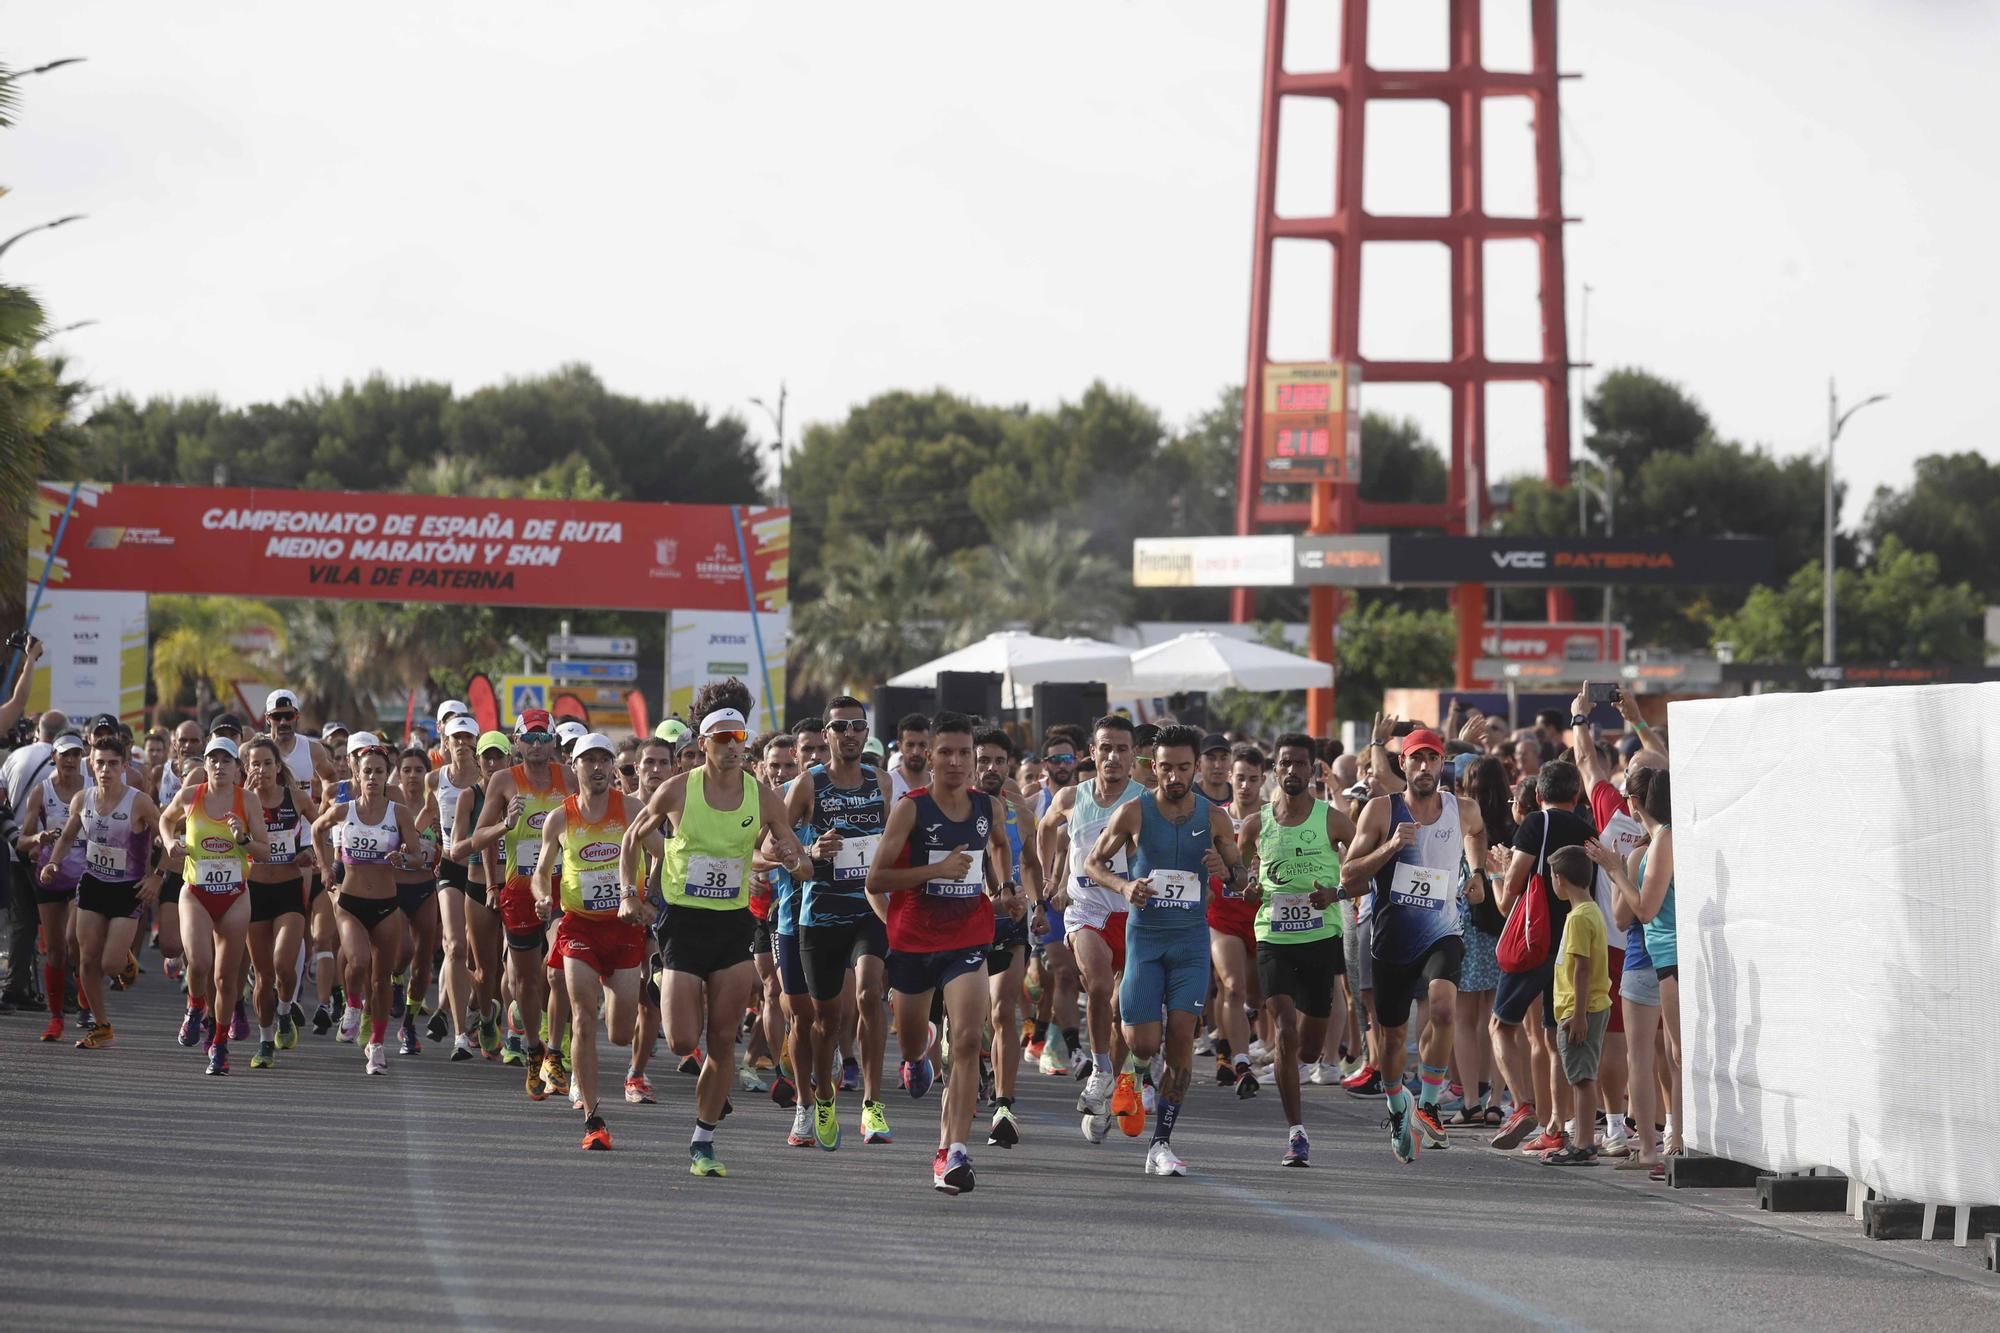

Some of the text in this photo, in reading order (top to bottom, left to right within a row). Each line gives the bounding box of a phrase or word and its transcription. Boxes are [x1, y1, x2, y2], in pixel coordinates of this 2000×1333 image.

[202, 508, 622, 543] CAMPEONATO DE ESPAÑA DE RUTA
[265, 536, 561, 566] MEDIO MARATÓN Y 5KM
[1492, 551, 1675, 568] VCC PATERNA
[309, 564, 514, 590] VILA DE PATERNA
[823, 811, 880, 826] vistasol
[351, 837, 378, 851] 392
[584, 847, 619, 859] Serrano
[858, 851, 865, 865] 1
[94, 854, 115, 869] 101
[205, 871, 232, 884] 407
[844, 869, 869, 879] Jom
[1286, 865, 1323, 876] MENORCA
[704, 872, 727, 887] 38
[592, 882, 620, 899] 235
[1165, 884, 1184, 899] 57
[1410, 880, 1431, 896] 79
[592, 898, 619, 910] Jom
[1281, 906, 1311, 920] 303
[1162, 1104, 1176, 1129] PAST
